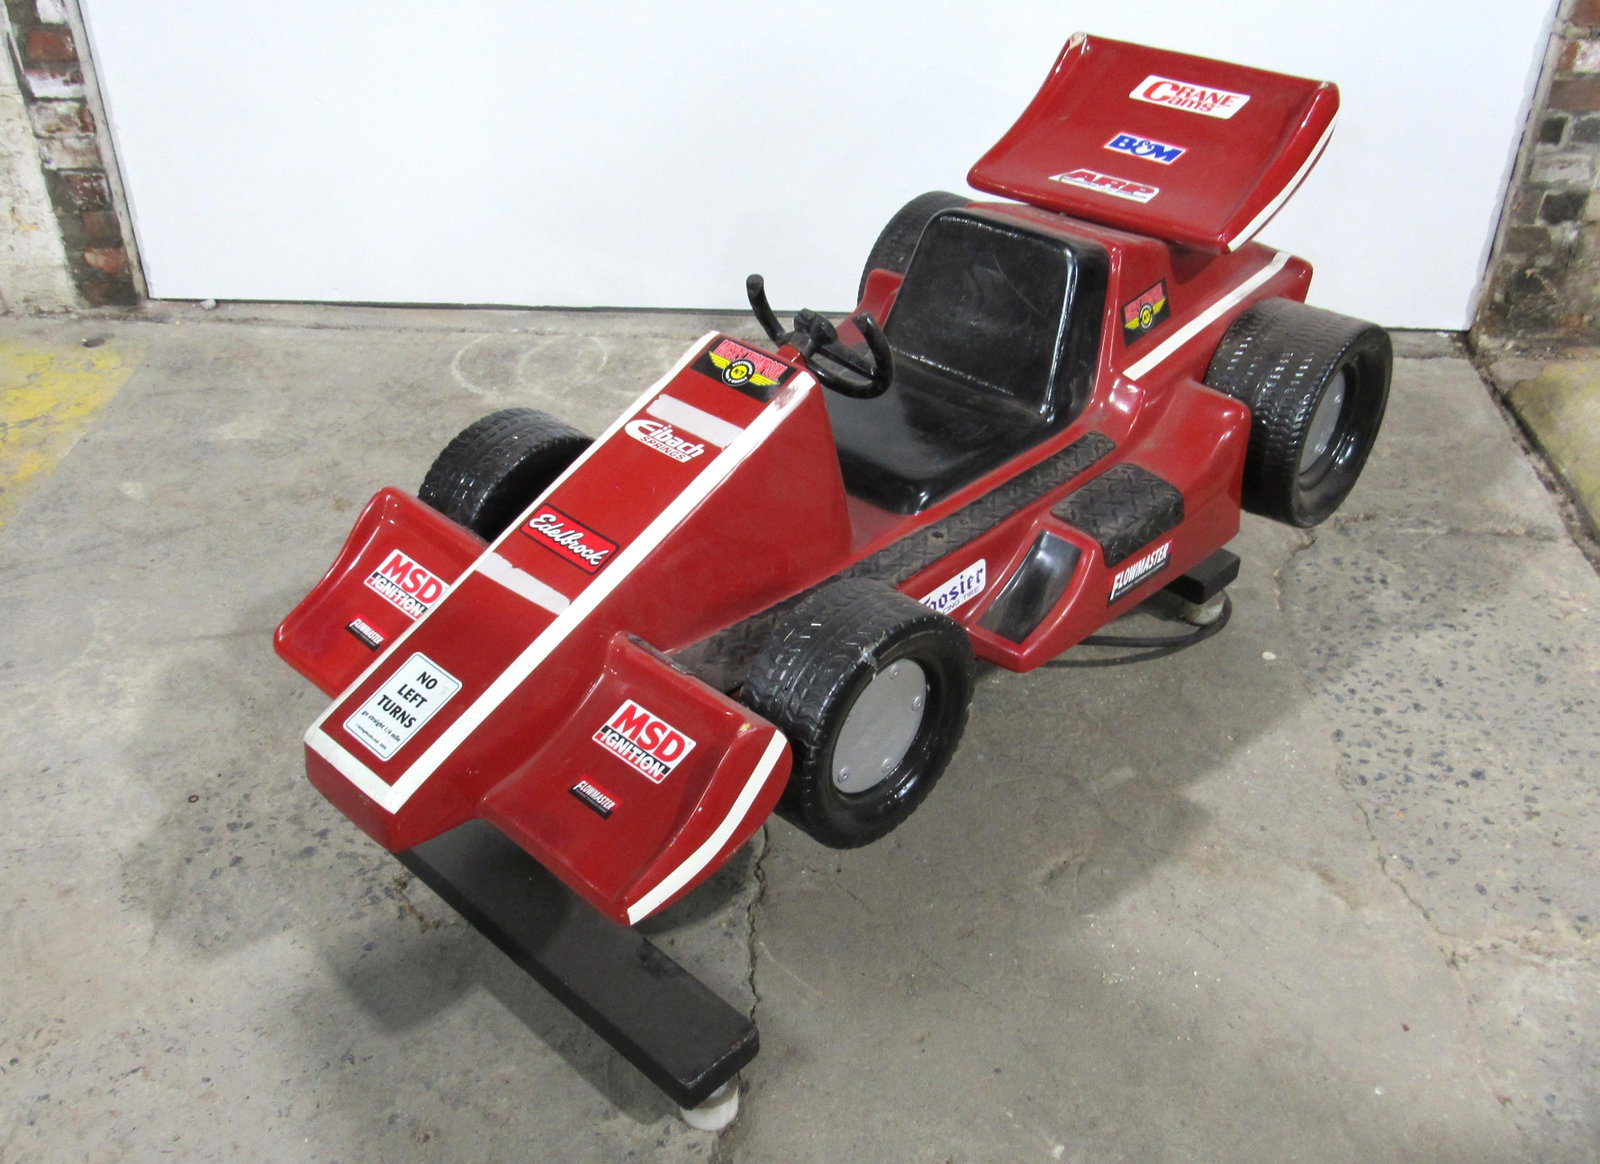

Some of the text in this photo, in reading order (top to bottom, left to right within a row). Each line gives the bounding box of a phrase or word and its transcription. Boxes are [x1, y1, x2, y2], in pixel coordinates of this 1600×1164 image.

[1143, 81, 1239, 108] CRANE
[1108, 134, 1183, 162] B&M
[1067, 172, 1155, 195] ARP
[624, 419, 705, 458] Eibach
[640, 436, 686, 460] SPRINGS
[529, 513, 609, 565] Edelbrock
[381, 553, 443, 604] MSD
[924, 568, 984, 611] oosier
[1109, 542, 1169, 601] FLOWMASTER
[370, 574, 424, 618] IGNITION
[397, 684, 428, 708] LEFT
[416, 671, 438, 690] NO
[377, 694, 417, 729] TURNS
[611, 704, 685, 763] MSD
[601, 729, 666, 778] IGNITION
[573, 780, 616, 810] FLOWMASTER
